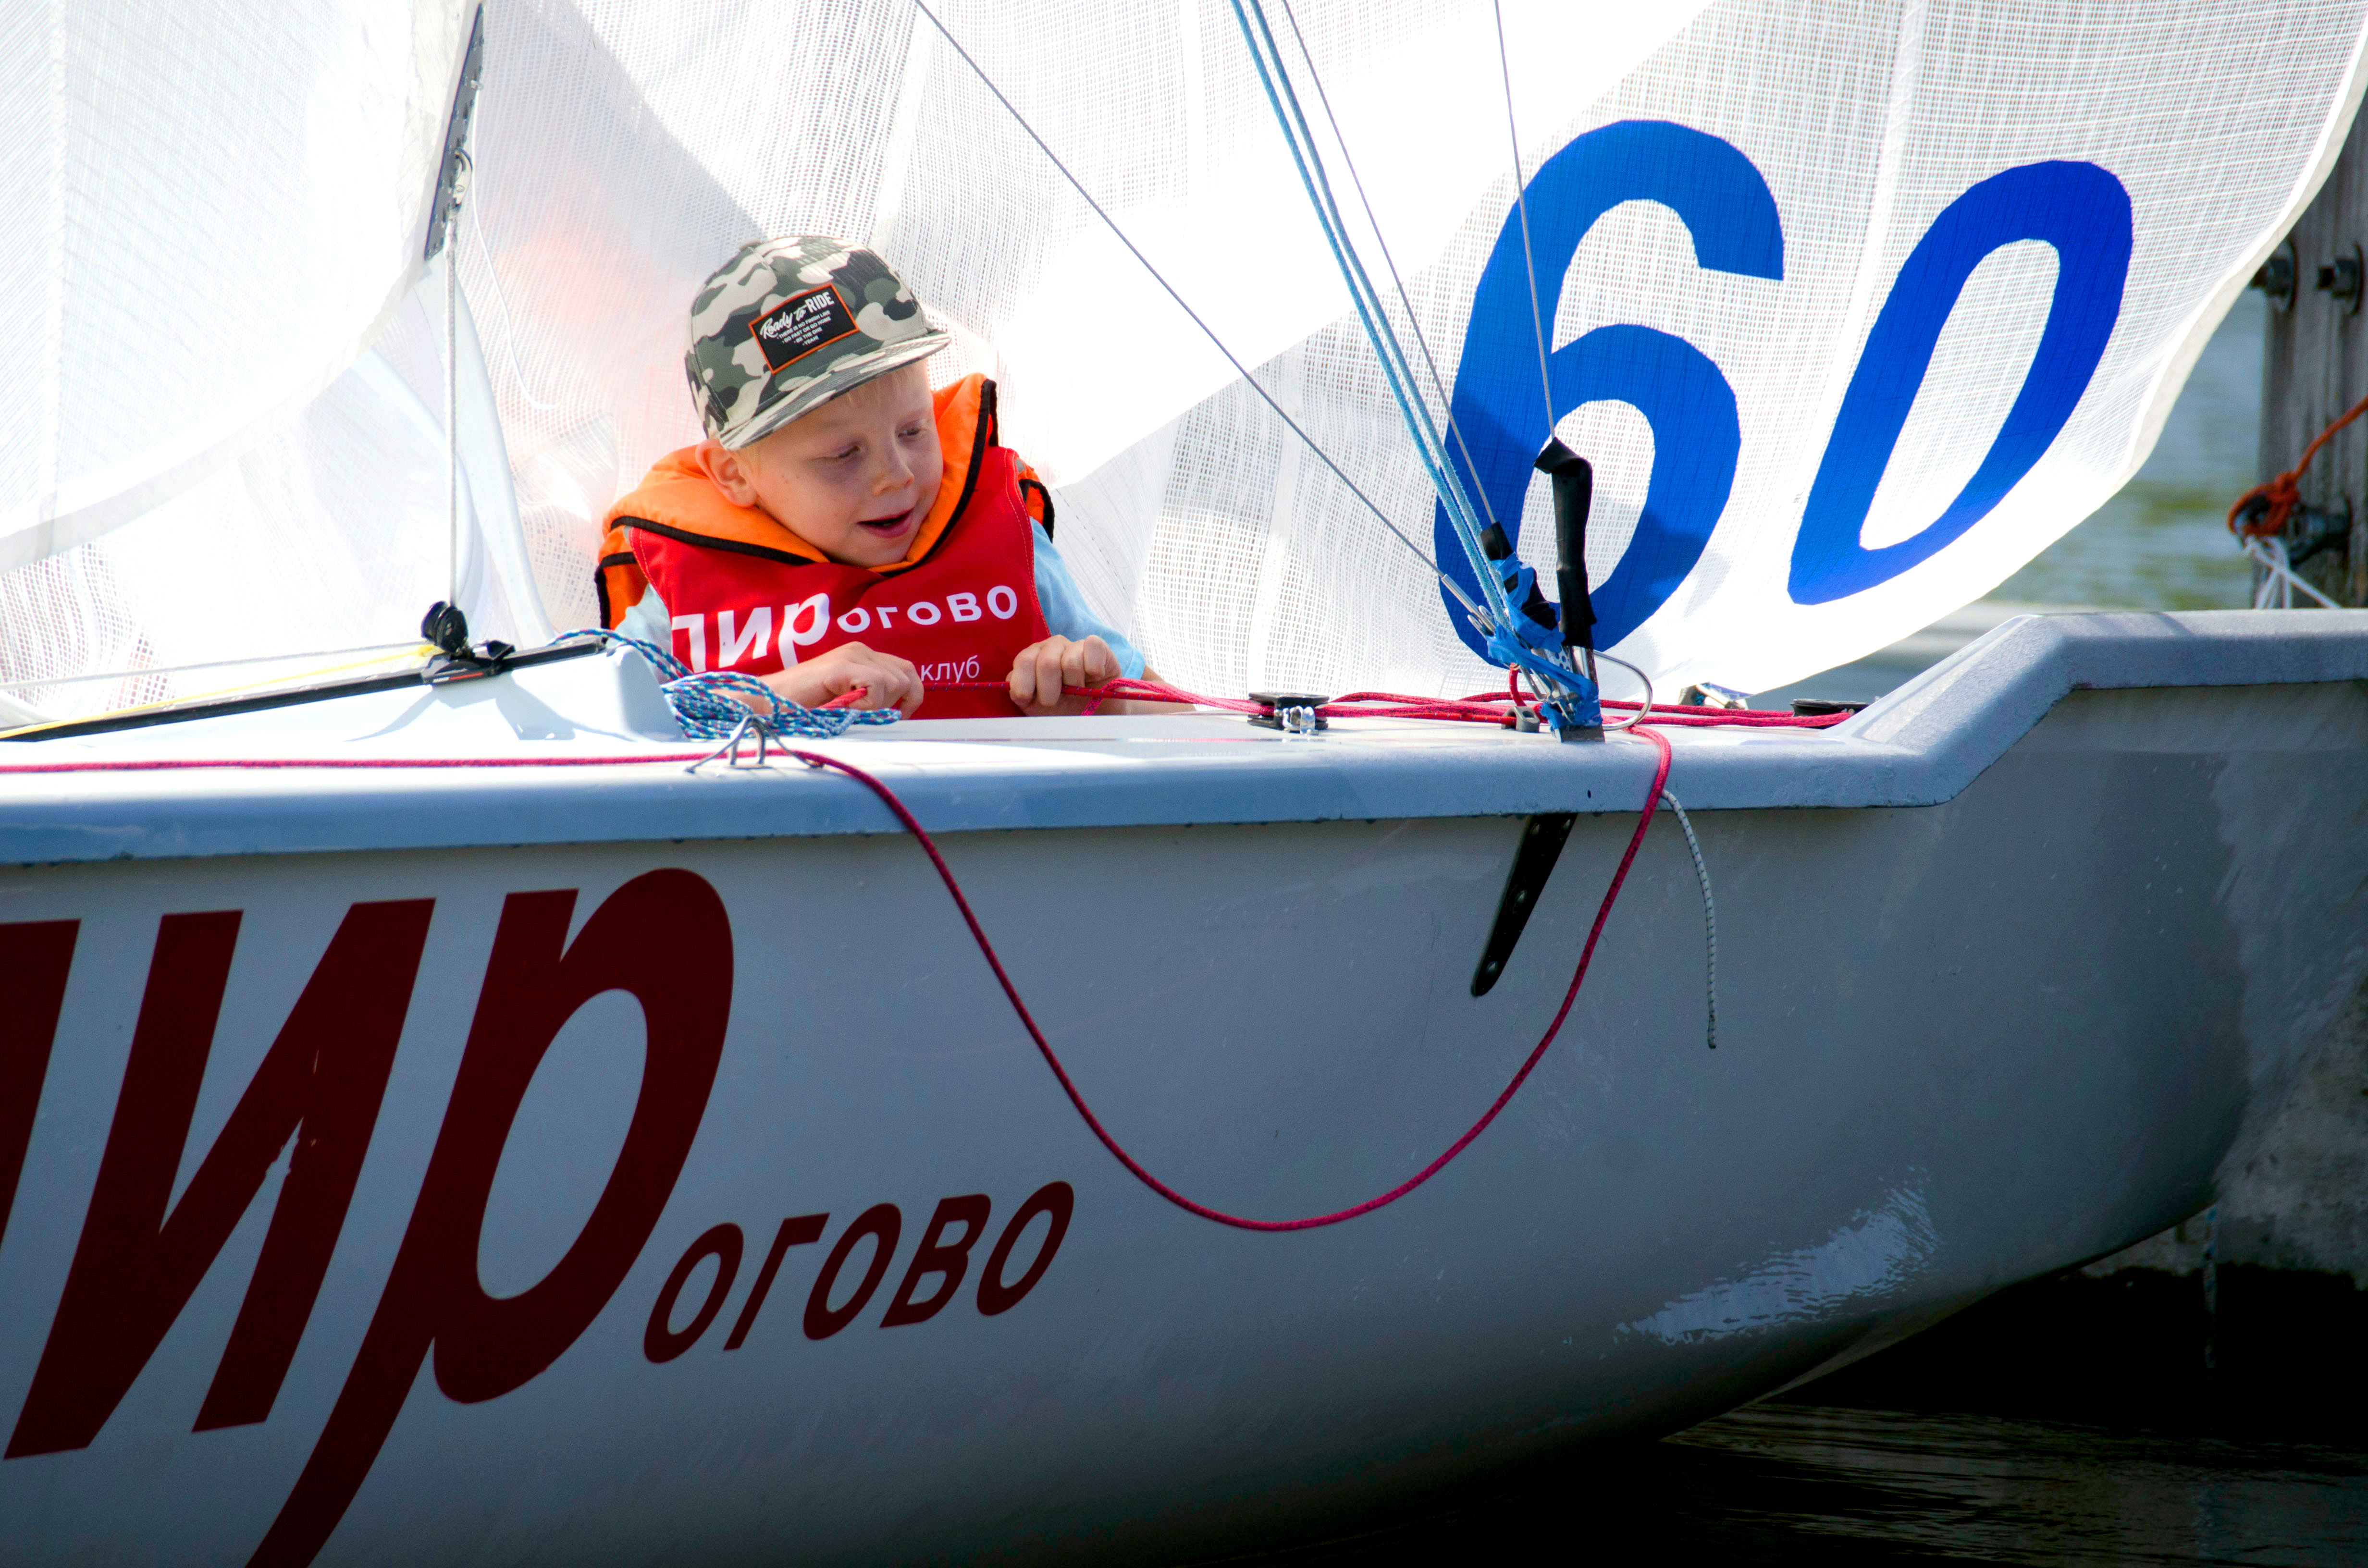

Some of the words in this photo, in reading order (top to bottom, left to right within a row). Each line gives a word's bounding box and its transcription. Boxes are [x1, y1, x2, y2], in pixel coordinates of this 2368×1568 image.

[760, 311, 793, 340] Ready
[793, 304, 807, 322] to
[805, 292, 835, 313] RIDE
[1434, 120, 2134, 668] 60
[921, 654, 980, 683] клуб
[0, 867, 1074, 1568] ирогово
